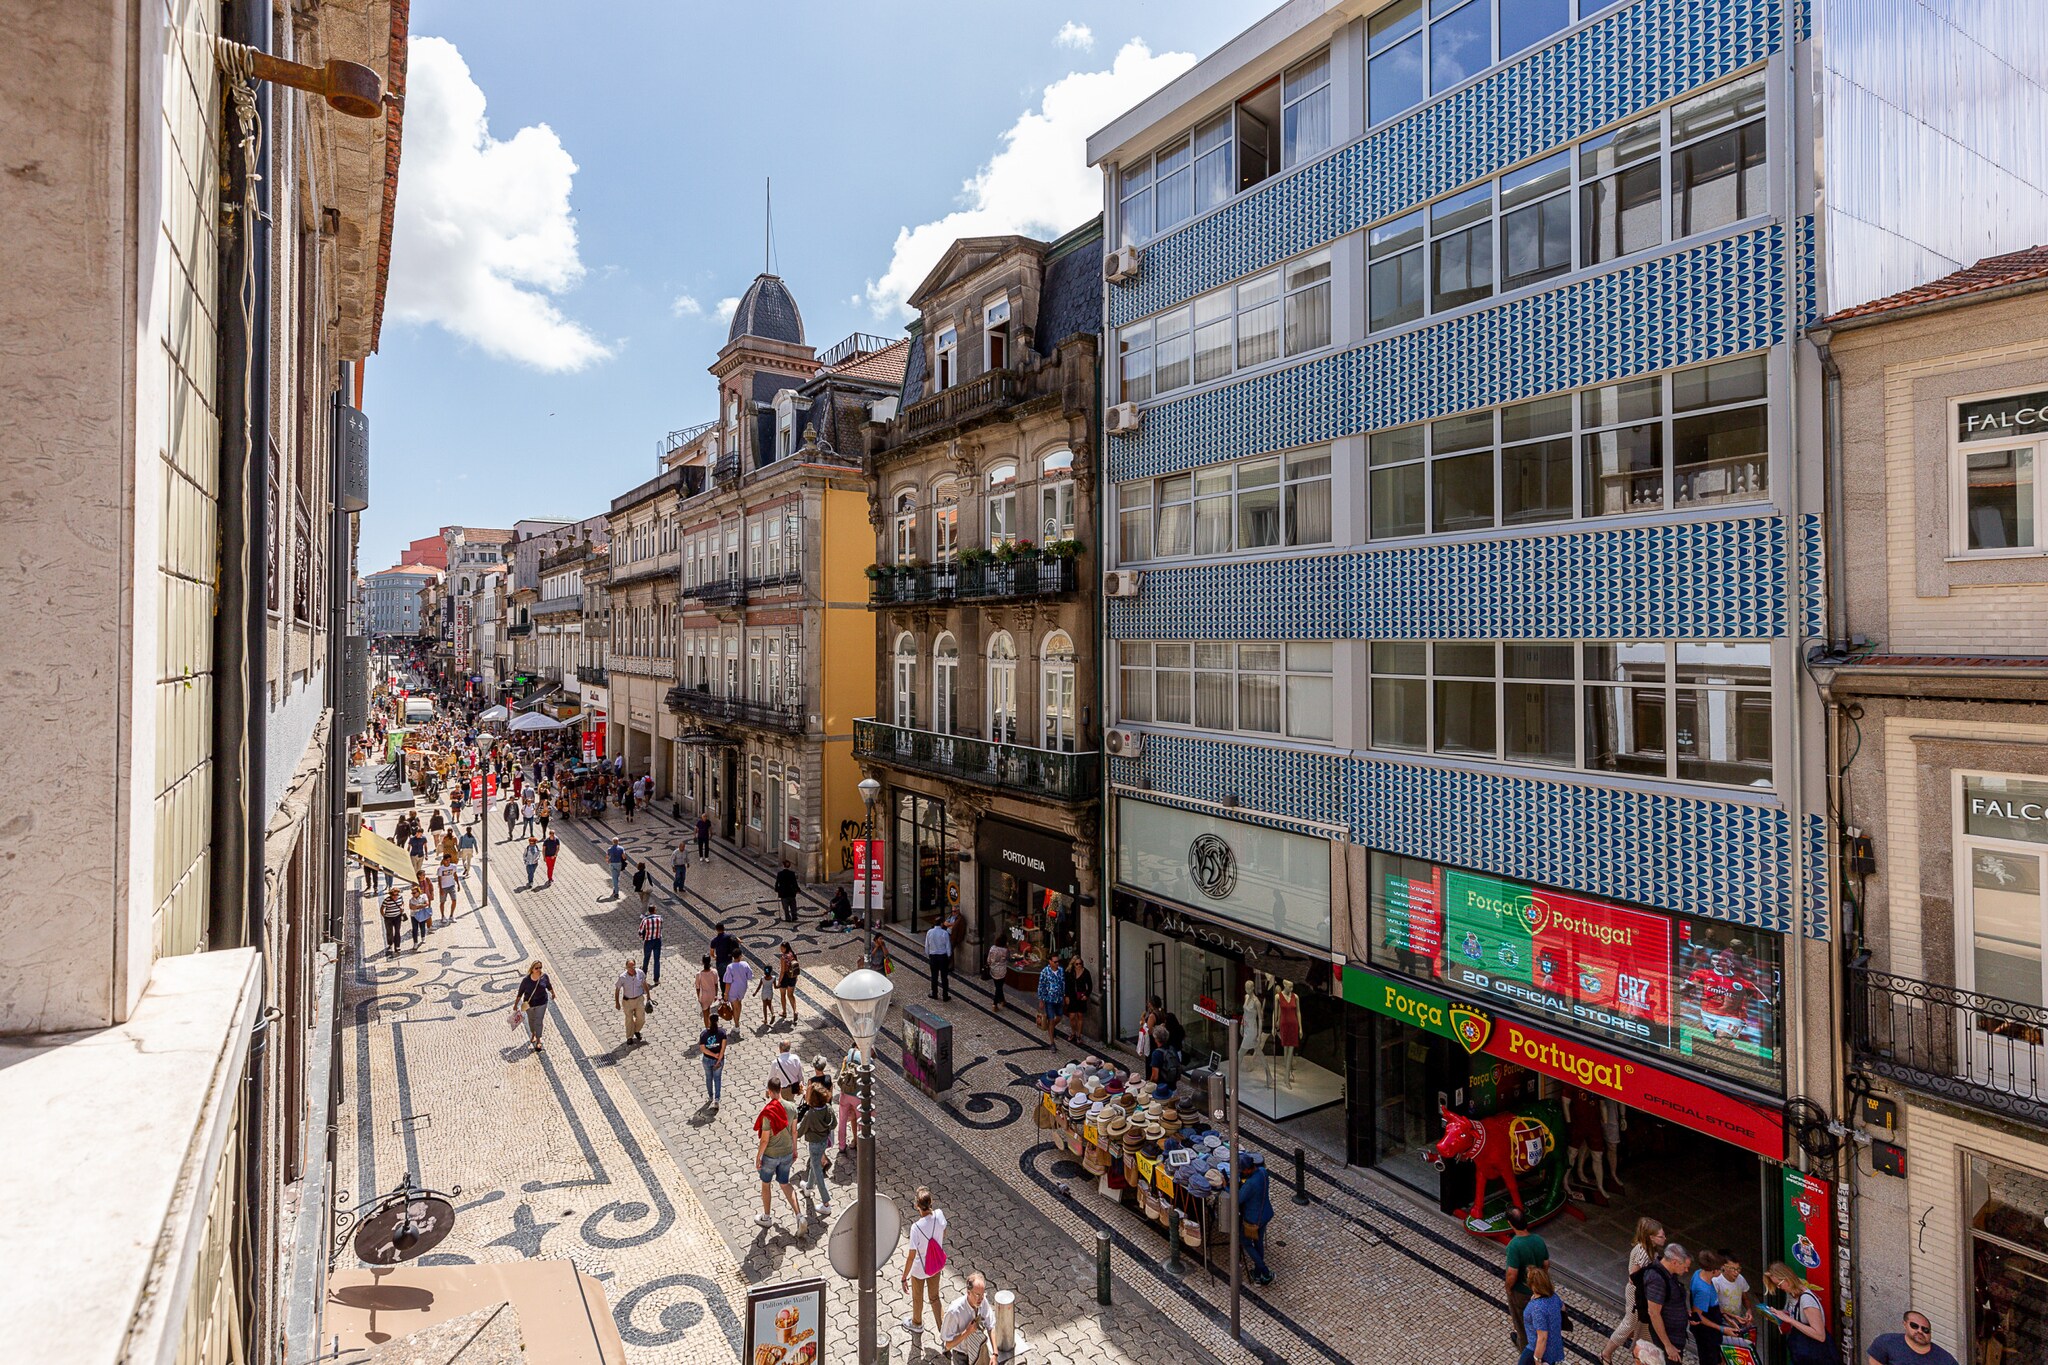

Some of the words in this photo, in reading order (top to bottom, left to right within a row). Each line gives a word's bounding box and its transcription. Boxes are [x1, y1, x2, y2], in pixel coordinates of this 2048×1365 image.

[1972, 797, 2048, 821] FALC
[1002, 849, 1026, 867] PORTO
[1027, 855, 1045, 873] MEIA
[1390, 880, 1436, 895] BEM-VINDO
[1393, 890, 1432, 904] WELCOME
[1467, 890, 1514, 919] Força
[1161, 916, 1197, 938] ANA
[1199, 928, 1258, 960] SOUSA
[1386, 917, 1440, 937] WILLKOMMEN
[1389, 927, 1437, 945] BENVENUTO
[1618, 973, 1650, 1003] CR7
[1385, 985, 1443, 1028] Força
[1462, 969, 1489, 988] 20
[1495, 980, 1569, 1012] OFFICIAL
[1573, 1003, 1650, 1037] STORES
[1468, 1072, 1490, 1088] Força
[1643, 1091, 1705, 1127] OFFICIAL
[1705, 1113, 1756, 1140] STORE
[762, 1300, 783, 1310] Palitos
[793, 1295, 812, 1304] Waffle
